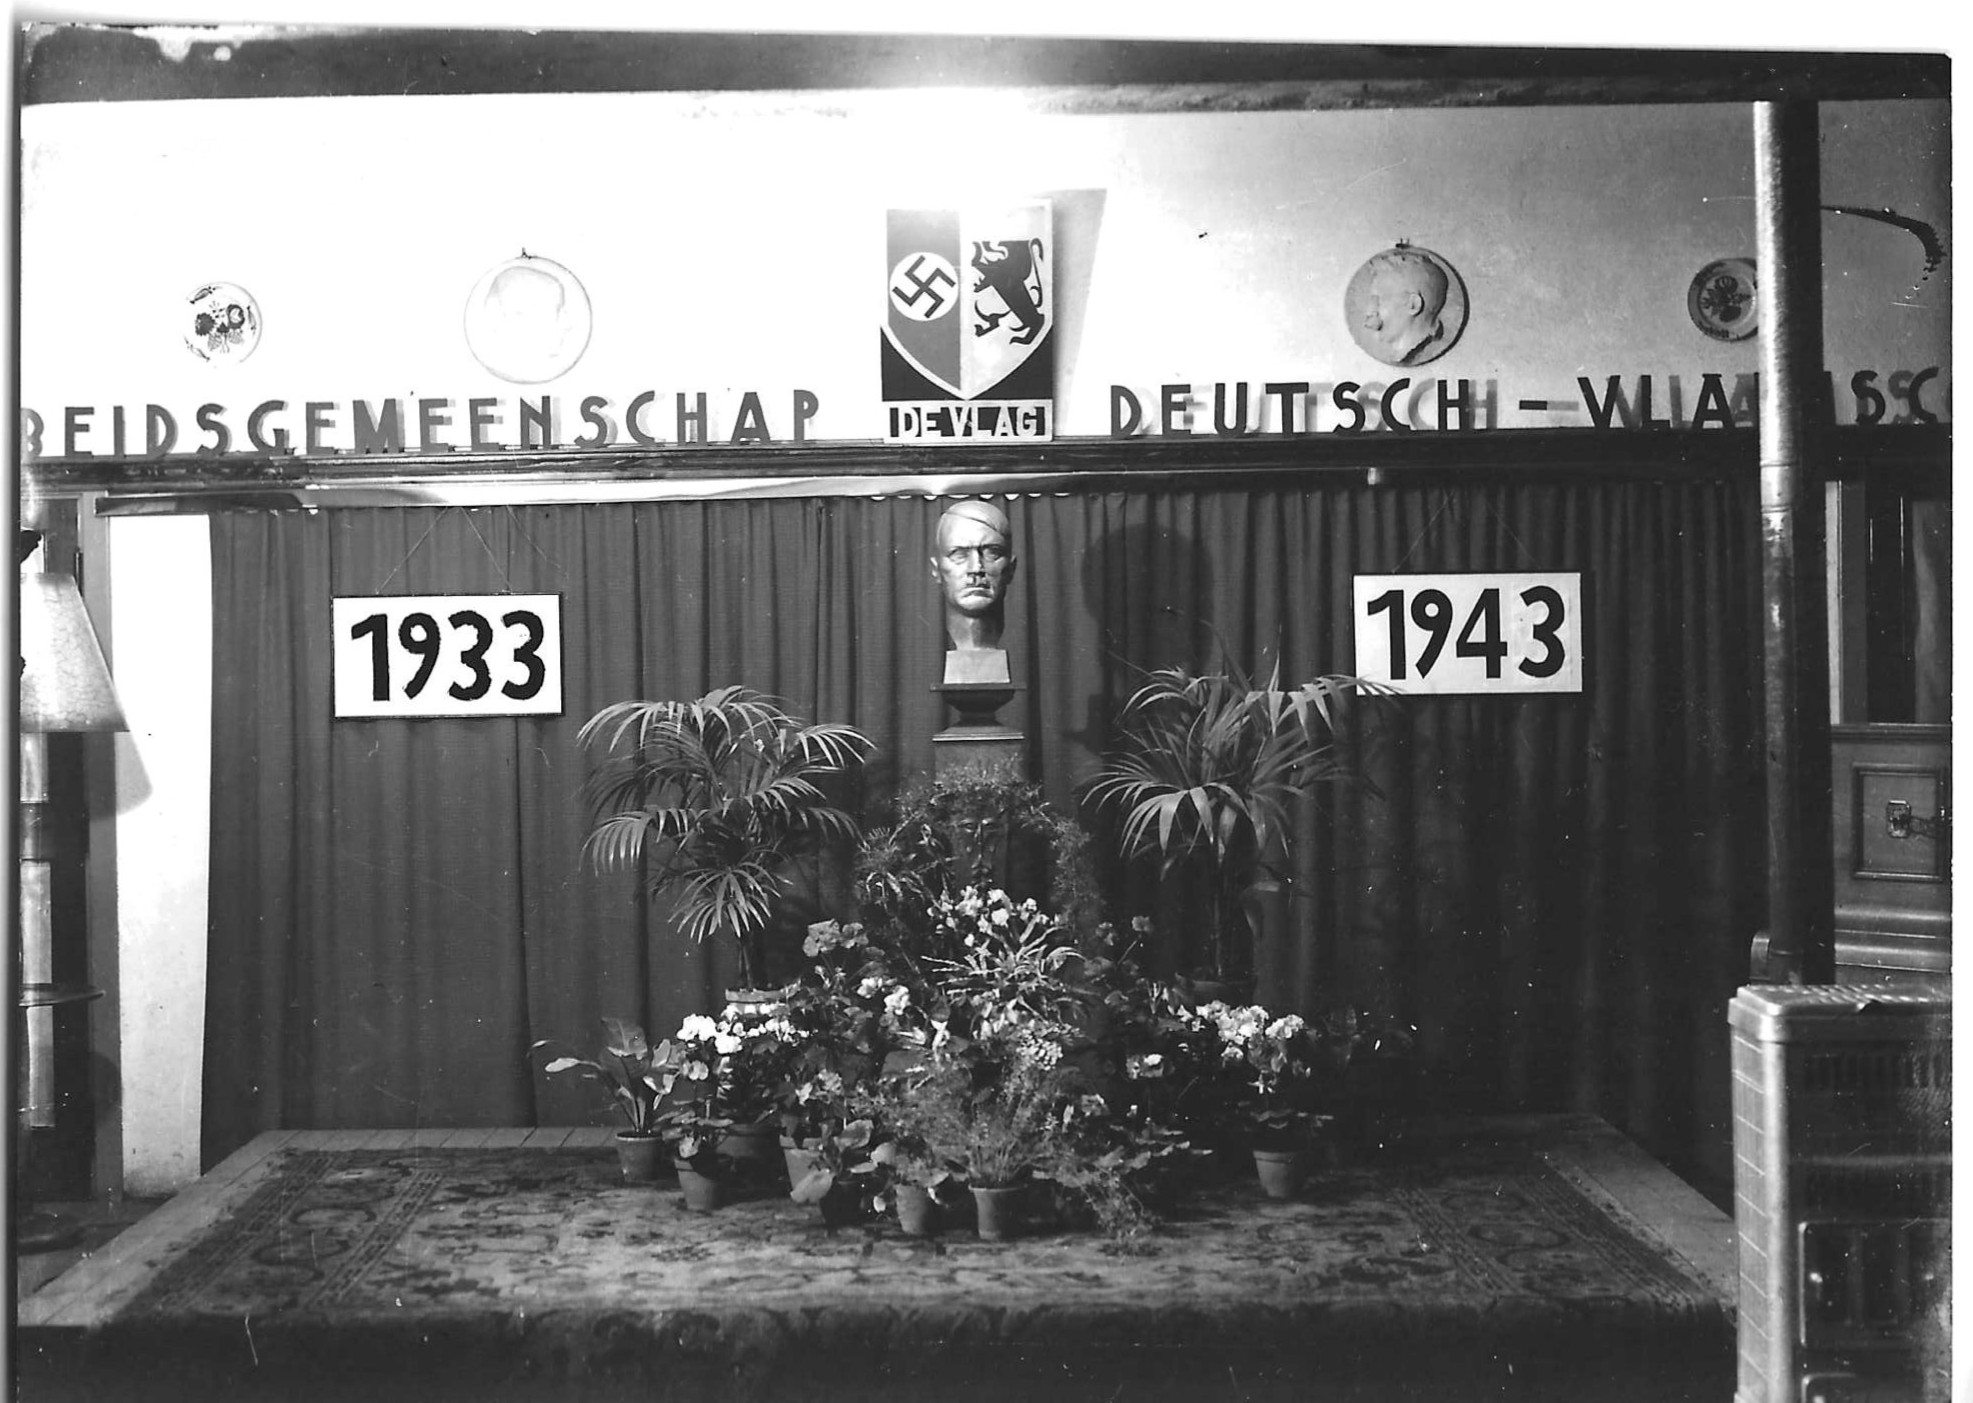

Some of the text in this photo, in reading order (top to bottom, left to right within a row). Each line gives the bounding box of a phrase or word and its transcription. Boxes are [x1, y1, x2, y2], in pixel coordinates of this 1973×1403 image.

[1110, 377, 1470, 438] DEUTSCH
[351, 609, 546, 702] 1933
[1367, 585, 1566, 680] 1943
